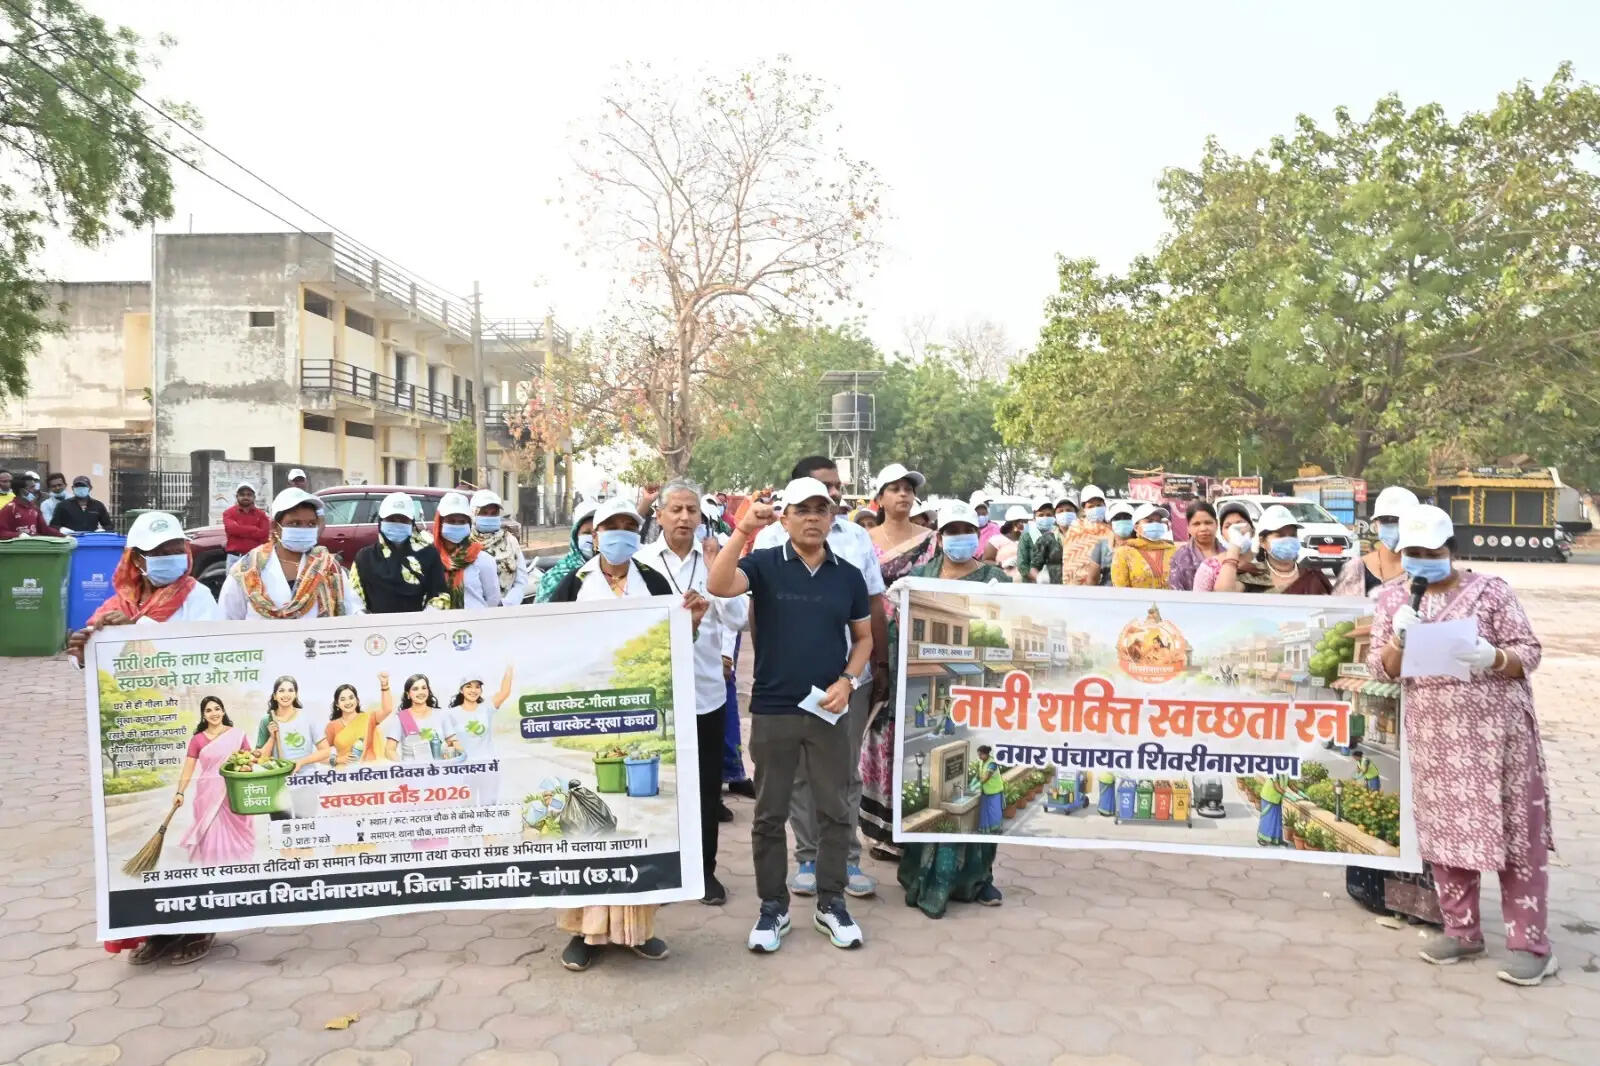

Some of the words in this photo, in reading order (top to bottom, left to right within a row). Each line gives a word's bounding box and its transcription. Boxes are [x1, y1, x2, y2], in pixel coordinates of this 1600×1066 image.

[112, 653, 139, 670] नारी
[143, 651, 178, 668] शक्ति
[182, 653, 210, 666] लाए
[214, 649, 265, 664] बदलाव
[118, 675, 155, 690] स्वच्छ
[158, 671, 179, 687] बने
[182, 672, 201, 686] घर
[205, 667, 230, 684] और
[233, 666, 260, 683] गांव
[113, 702, 124, 710] घर
[125, 701, 133, 709] से
[145, 698, 163, 708] गीला
[166, 697, 178, 707] और
[524, 700, 544, 713] हरा
[546, 693, 617, 710] बास्केट-गीला
[618, 693, 650, 706] कचरा
[951, 673, 1032, 730] नारी
[1037, 676, 1143, 736] शक्ति
[1149, 698, 1290, 741] स्वच्छता
[1295, 703, 1350, 744] रन
[159, 714, 178, 722] अलग
[522, 719, 550, 733] नीला
[552, 715, 621, 733] बास्केट-सूखा
[623, 714, 655, 727] कचरा
[127, 729, 137, 738] की
[140, 729, 160, 738] आदत
[111, 745, 124, 754] और
[126, 742, 174, 753] शिवरीनारायण
[176, 741, 186, 750] को
[996, 743, 1048, 766] नगर
[1051, 742, 1134, 769] पंचायत
[1137, 742, 1300, 777] शिवरीनारायण
[287, 769, 347, 786] अंतर्राष्ट्रीय
[349, 767, 388, 782] महिला
[389, 763, 425, 780] दिवस
[427, 762, 441, 777] के
[442, 761, 485, 776] उपलक्ष्य
[485, 759, 500, 774] में
[319, 791, 385, 809] स्वच्छता
[388, 784, 421, 806] दौड़
[423, 786, 471, 802] 2026
[295, 824, 300, 832] 9
[302, 821, 316, 831] मार्च
[369, 817, 387, 826] स्थान
[410, 814, 432, 823] नटराज
[434, 811, 449, 821] चौक
[450, 811, 457, 820] से
[476, 808, 496, 818] मार्केट
[497, 808, 510, 817] तक
[467, 824, 484, 833] चौक
[318, 834, 331, 843] बजे
[143, 870, 160, 883] इस
[164, 867, 198, 881] अवसर
[201, 866, 216, 877] पर
[219, 863, 260, 876] स्वच्छता
[263, 857, 302, 873] दीदियों
[304, 857, 321, 869] का
[322, 855, 356, 868] सम्मान
[358, 852, 386, 866] किया
[390, 851, 423, 864] जाएगा
[425, 850, 448, 861] तथा
[451, 847, 480, 860] कचरा
[484, 843, 509, 857] संग्रह
[512, 841, 553, 856] अभियान
[555, 839, 568, 854] भी
[571, 840, 607, 852] चलाया
[155, 896, 197, 913] नगर
[200, 890, 268, 909] पंचायत
[269, 879, 402, 904] शिवरीनारायण,
[583, 864, 639, 885] (छ.ग.)
